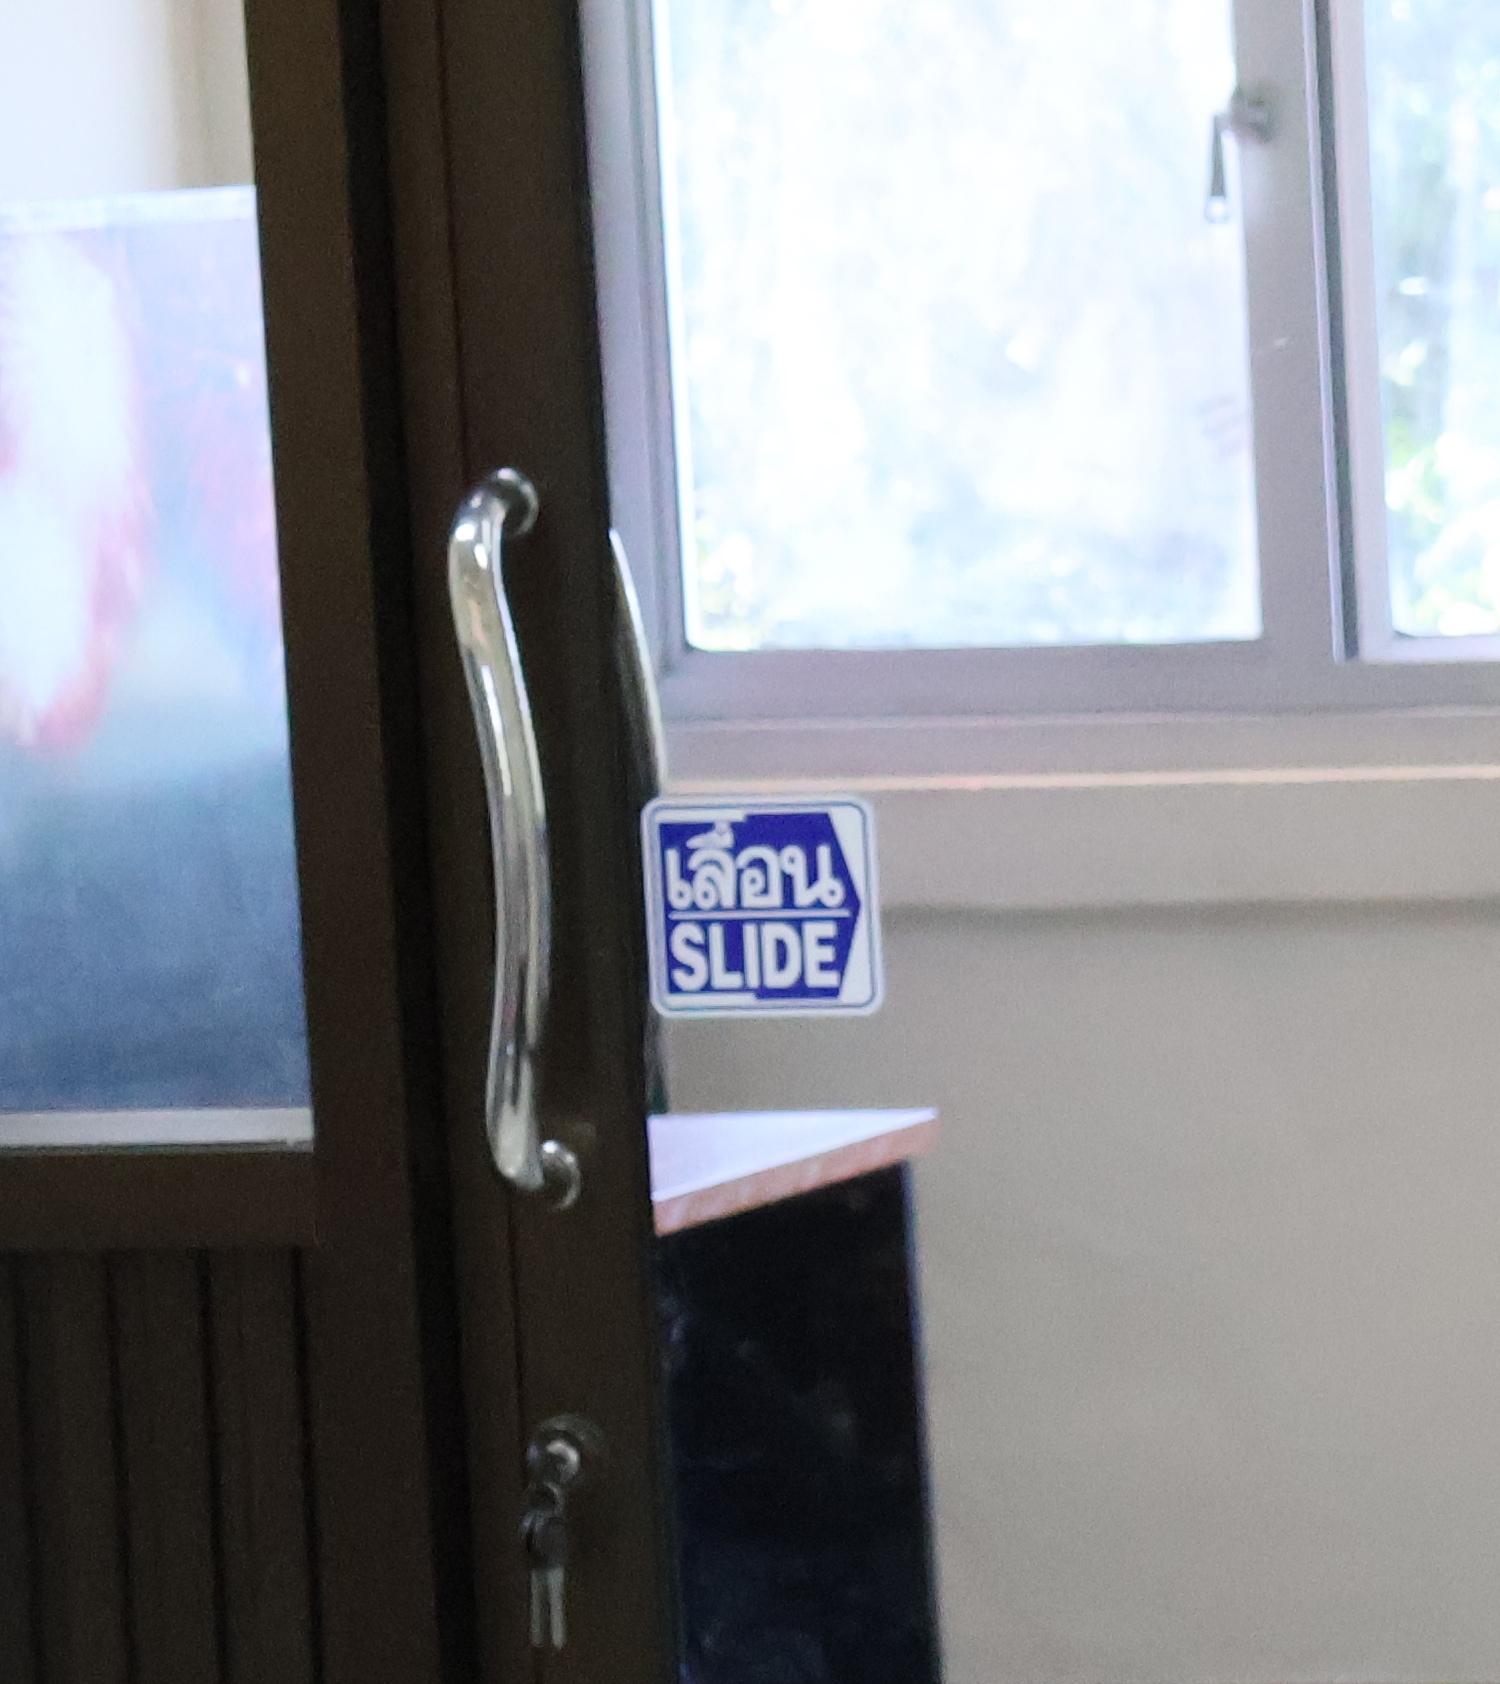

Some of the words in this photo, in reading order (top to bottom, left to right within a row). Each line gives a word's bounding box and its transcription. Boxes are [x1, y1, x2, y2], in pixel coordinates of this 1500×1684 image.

[664, 820, 846, 910] เลื่อน
[669, 921, 841, 992] SLIDE
